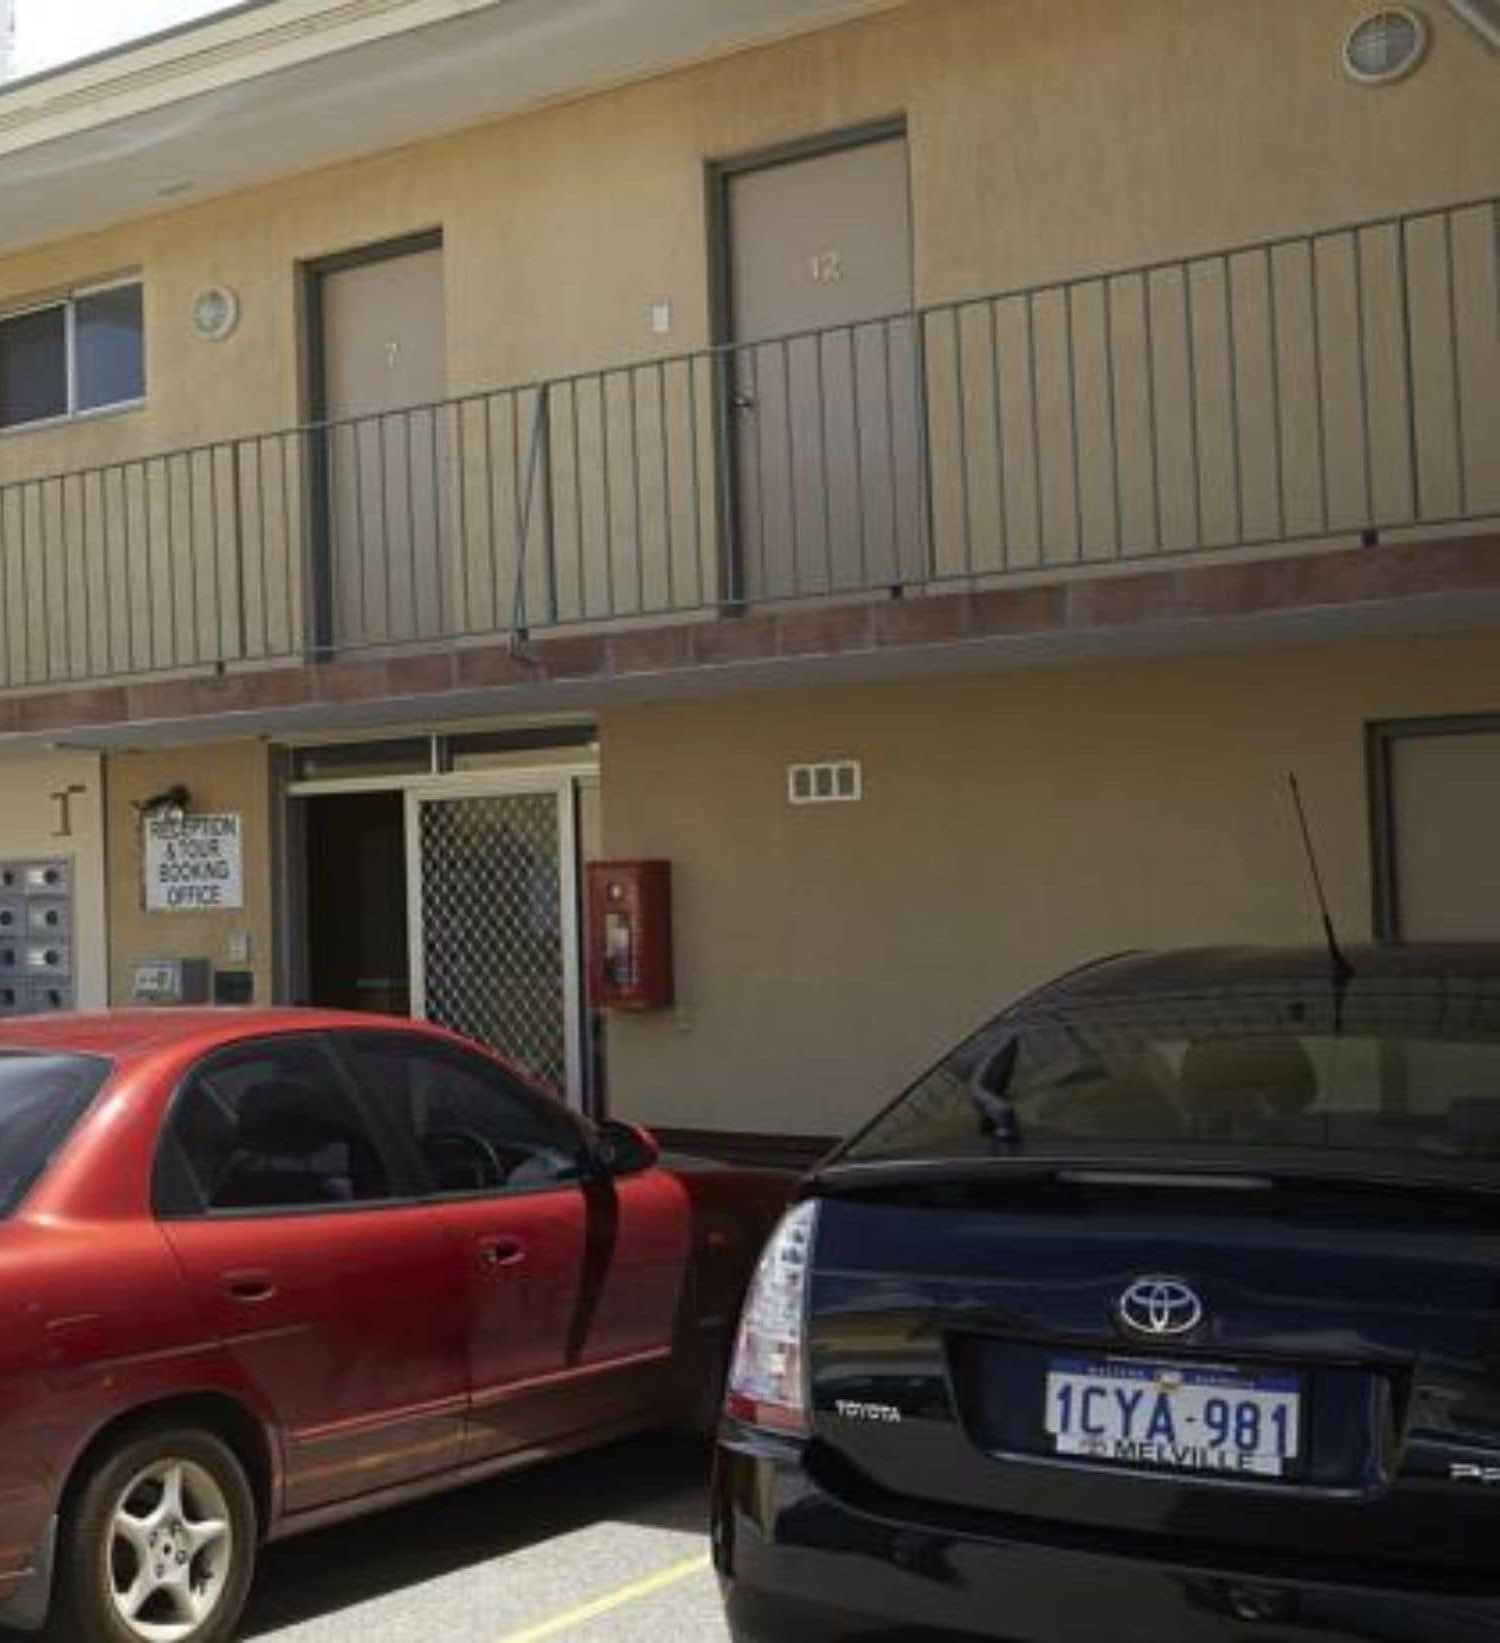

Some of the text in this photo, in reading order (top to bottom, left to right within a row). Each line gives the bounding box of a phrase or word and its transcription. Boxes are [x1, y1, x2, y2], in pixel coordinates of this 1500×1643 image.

[806, 251, 842, 281] 12
[150, 816, 237, 839] RECEPTION
[179, 838, 221, 858] TOUR
[160, 860, 230, 883] BOOKING
[167, 885, 221, 905] OFFICE
[835, 1399, 901, 1422] TOYOTA
[1057, 1384, 1289, 1457] 1CYA-981
[1114, 1440, 1255, 1470] MELVILLE
